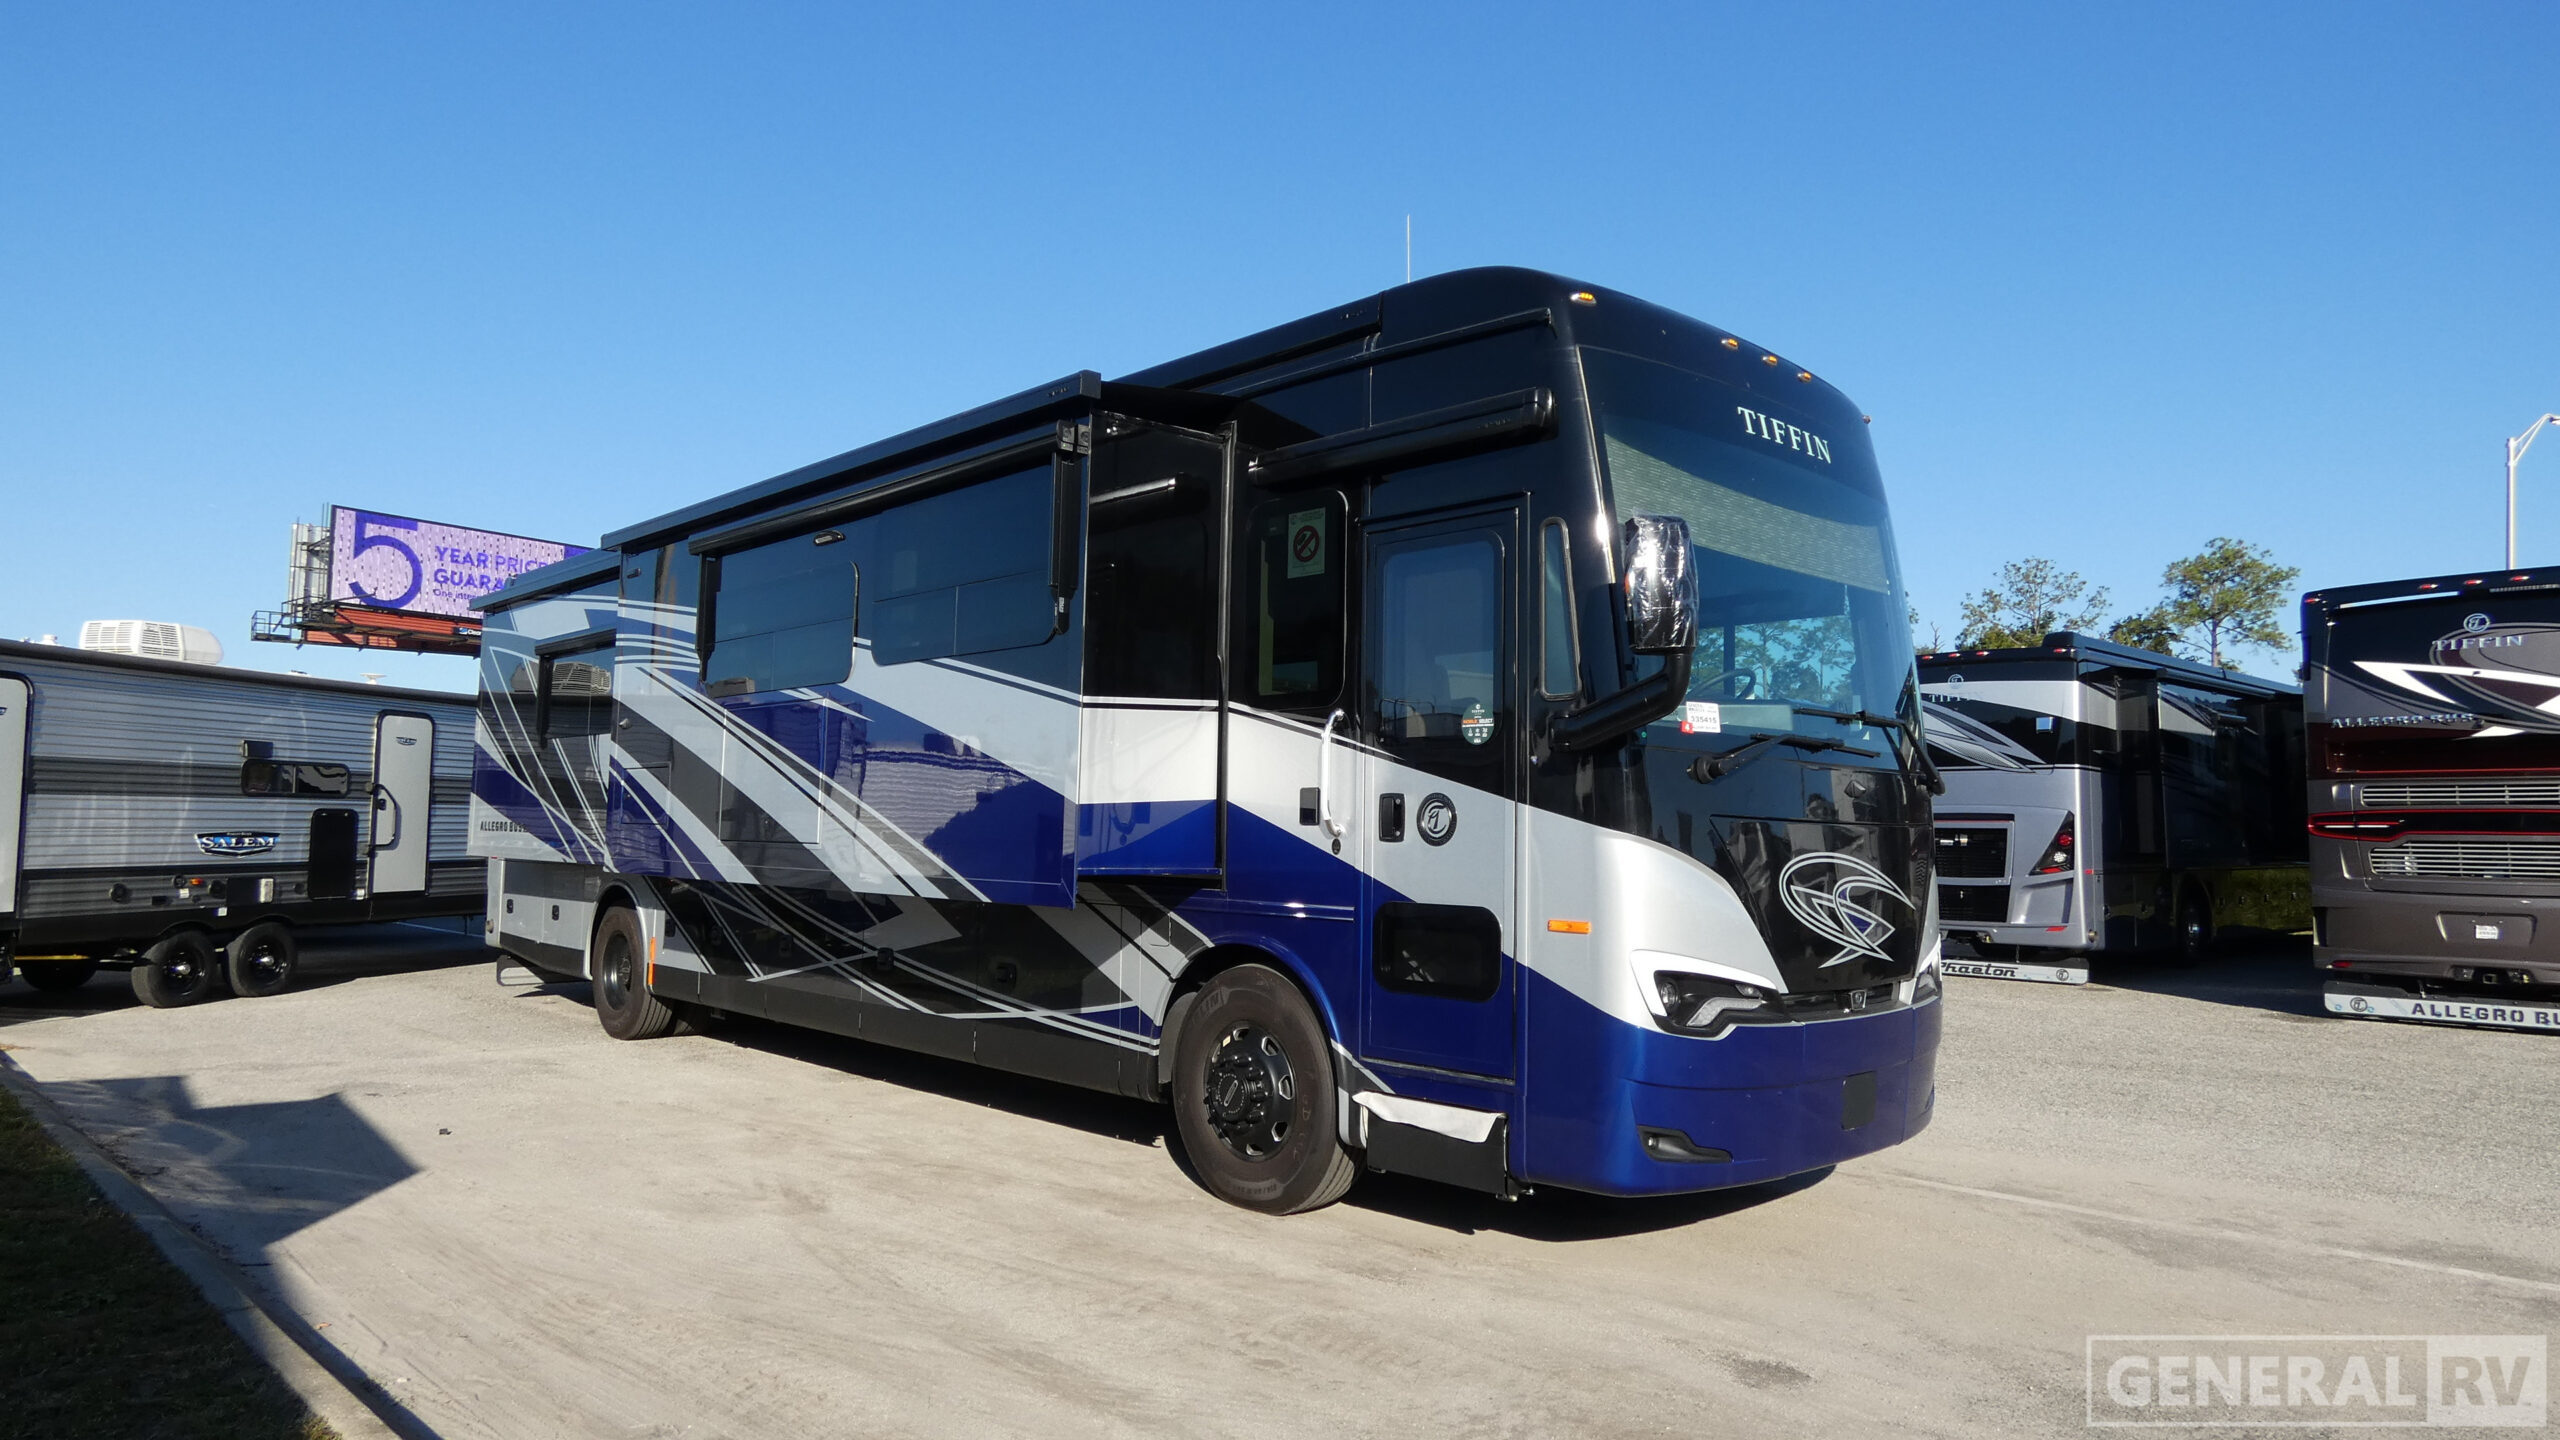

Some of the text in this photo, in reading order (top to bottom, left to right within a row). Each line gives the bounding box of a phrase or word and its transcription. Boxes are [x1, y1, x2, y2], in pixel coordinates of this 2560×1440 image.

[1737, 405, 1832, 464] TIFFIN
[348, 511, 423, 610] 5
[434, 545, 490, 568] YEAR
[2431, 635, 2523, 651] TIFFIN
[1928, 690, 1983, 703] TIFF
[480, 820, 508, 832] ALLEGRO
[201, 835, 276, 849] SALEM
[2411, 1002, 2525, 1023] ALLEGRO
